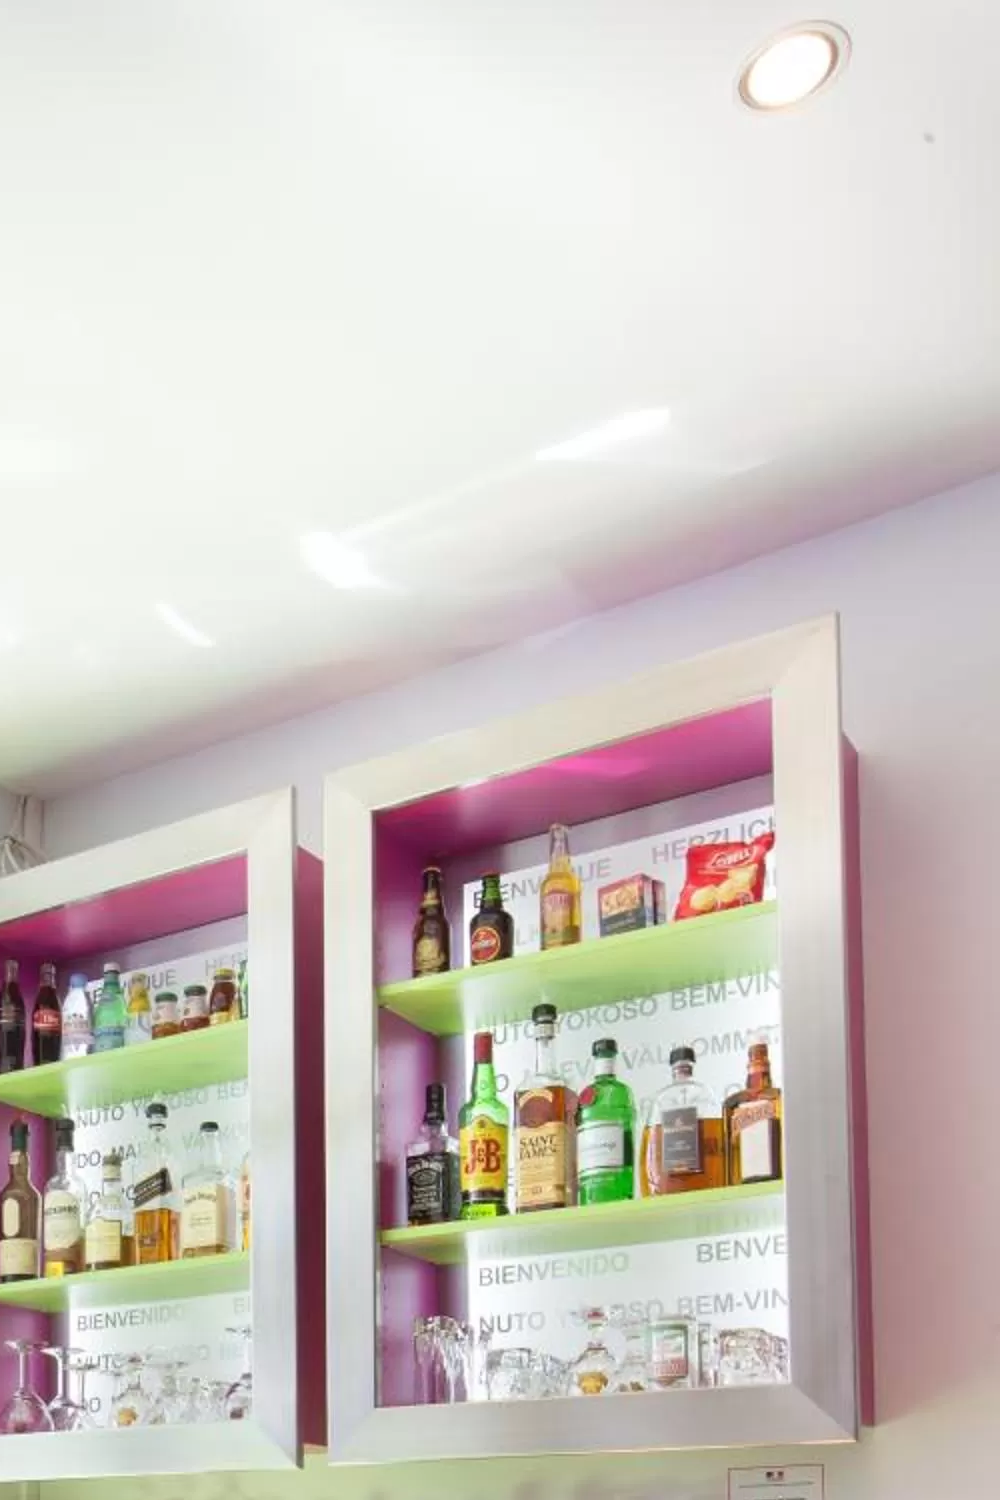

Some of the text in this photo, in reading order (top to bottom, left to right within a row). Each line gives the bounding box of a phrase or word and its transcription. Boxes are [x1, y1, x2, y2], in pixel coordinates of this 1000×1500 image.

[519, 1134, 558, 1147] SAINT
[464, 1137, 501, 1175] J&B
[478, 1252, 630, 1287] BIENVENIDO
[77, 1305, 186, 1331] BIENVENIDO
